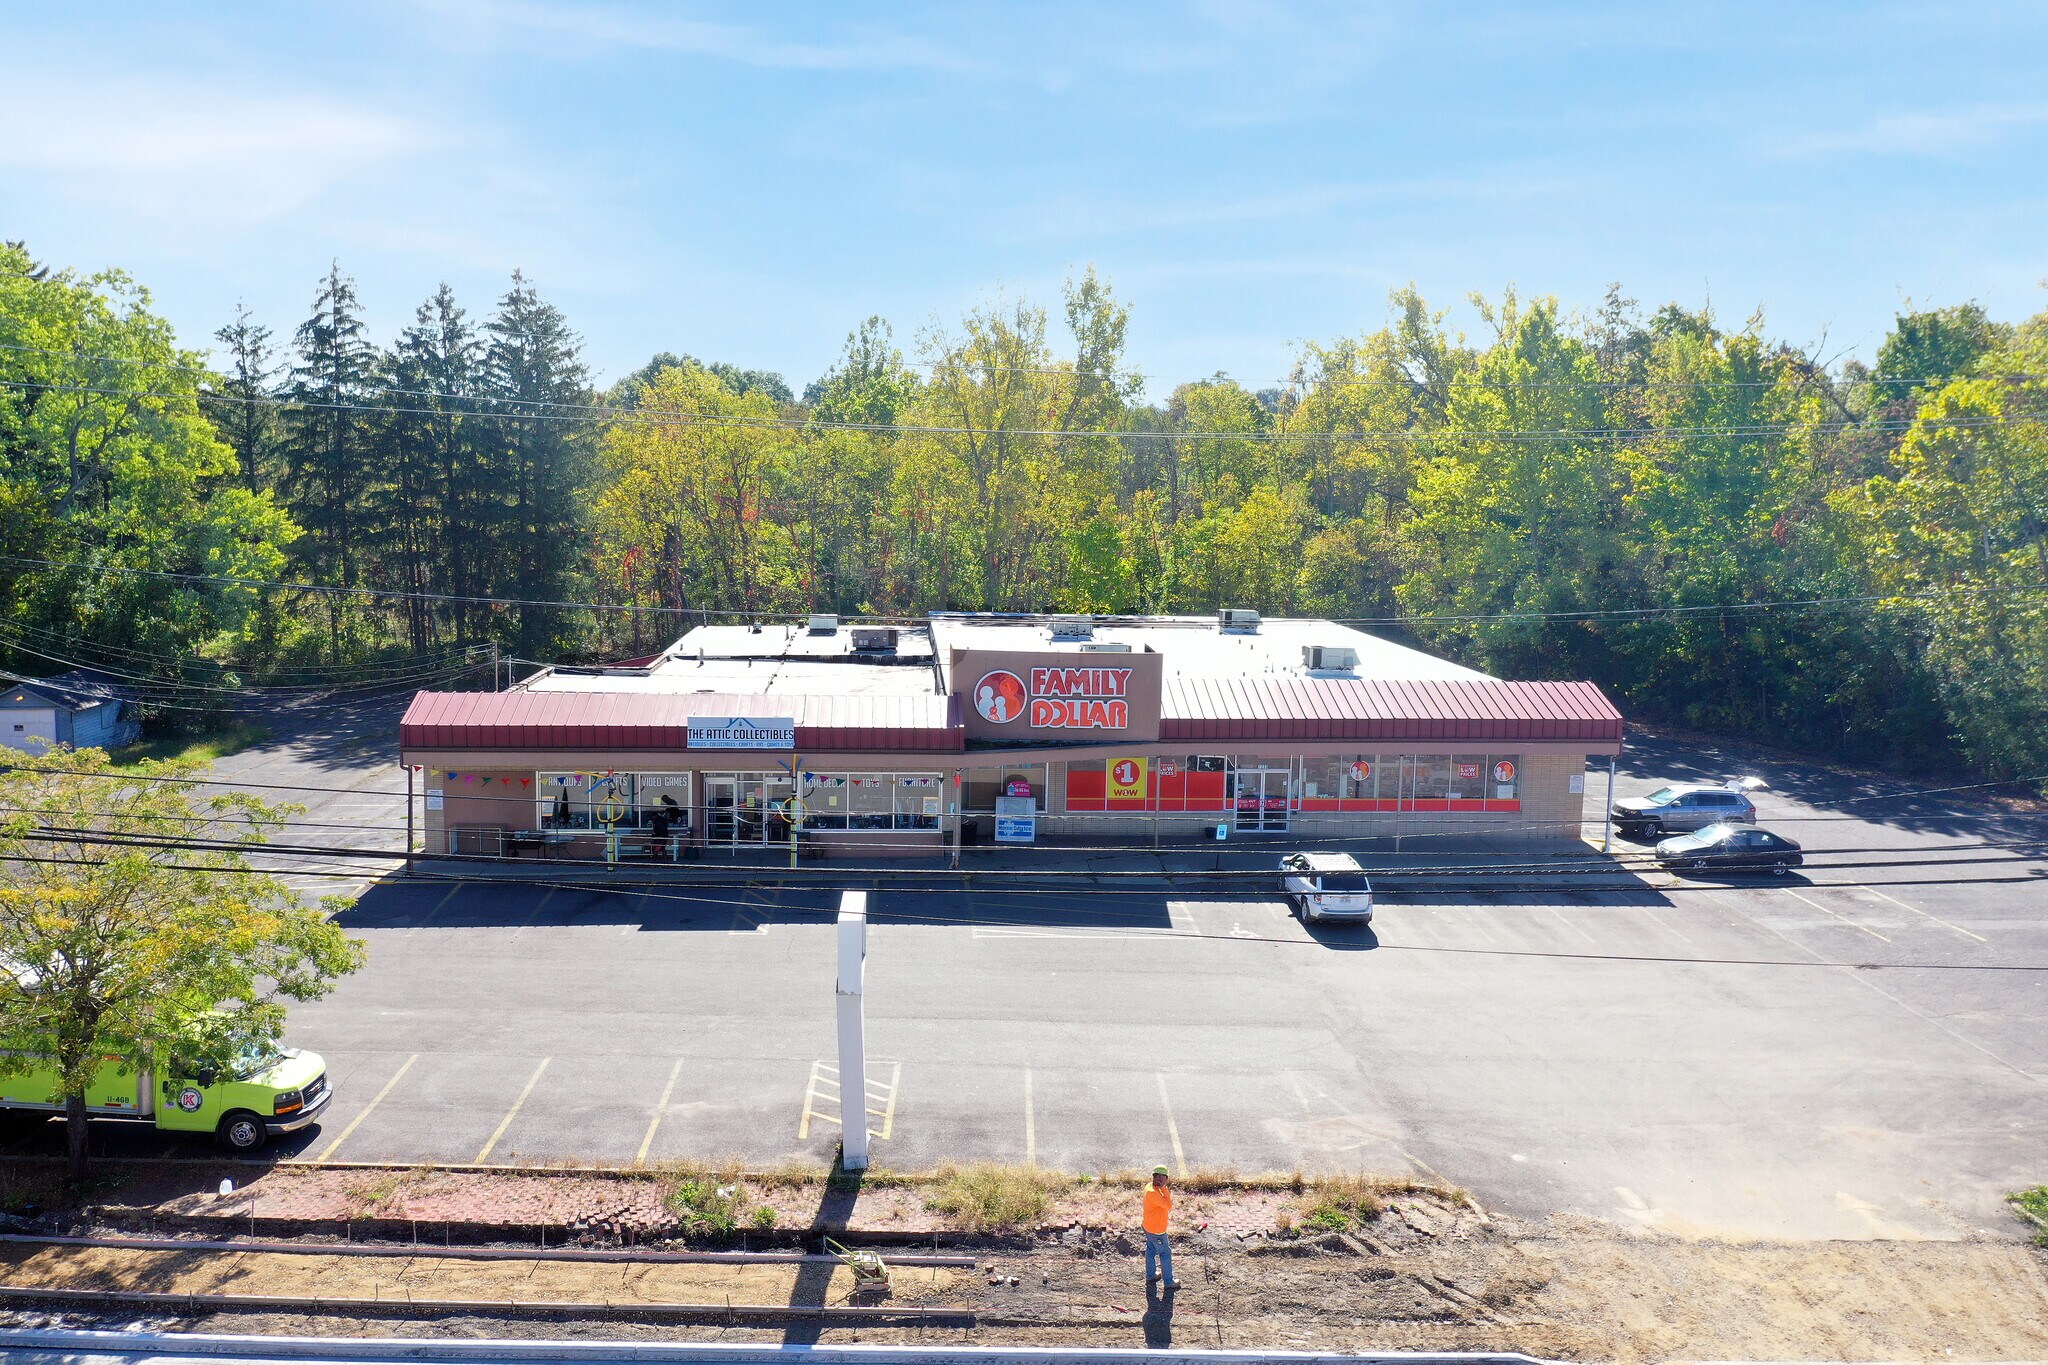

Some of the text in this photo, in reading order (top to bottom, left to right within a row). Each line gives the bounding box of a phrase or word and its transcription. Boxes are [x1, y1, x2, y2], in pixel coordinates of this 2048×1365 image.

[1031, 668, 1132, 696] FAMILY
[1030, 698, 1128, 728] DOLLAR
[688, 728, 794, 740] THE ATTIC COLLECTIBLES
[1115, 762, 1134, 783] $1
[548, 776, 582, 786] ANQUES
[642, 776, 688, 786] VIDEO GAMES
[804, 778, 846, 788] HOME DEC
[862, 778, 880, 788] TOYS
[183, 1094, 196, 1106] K
